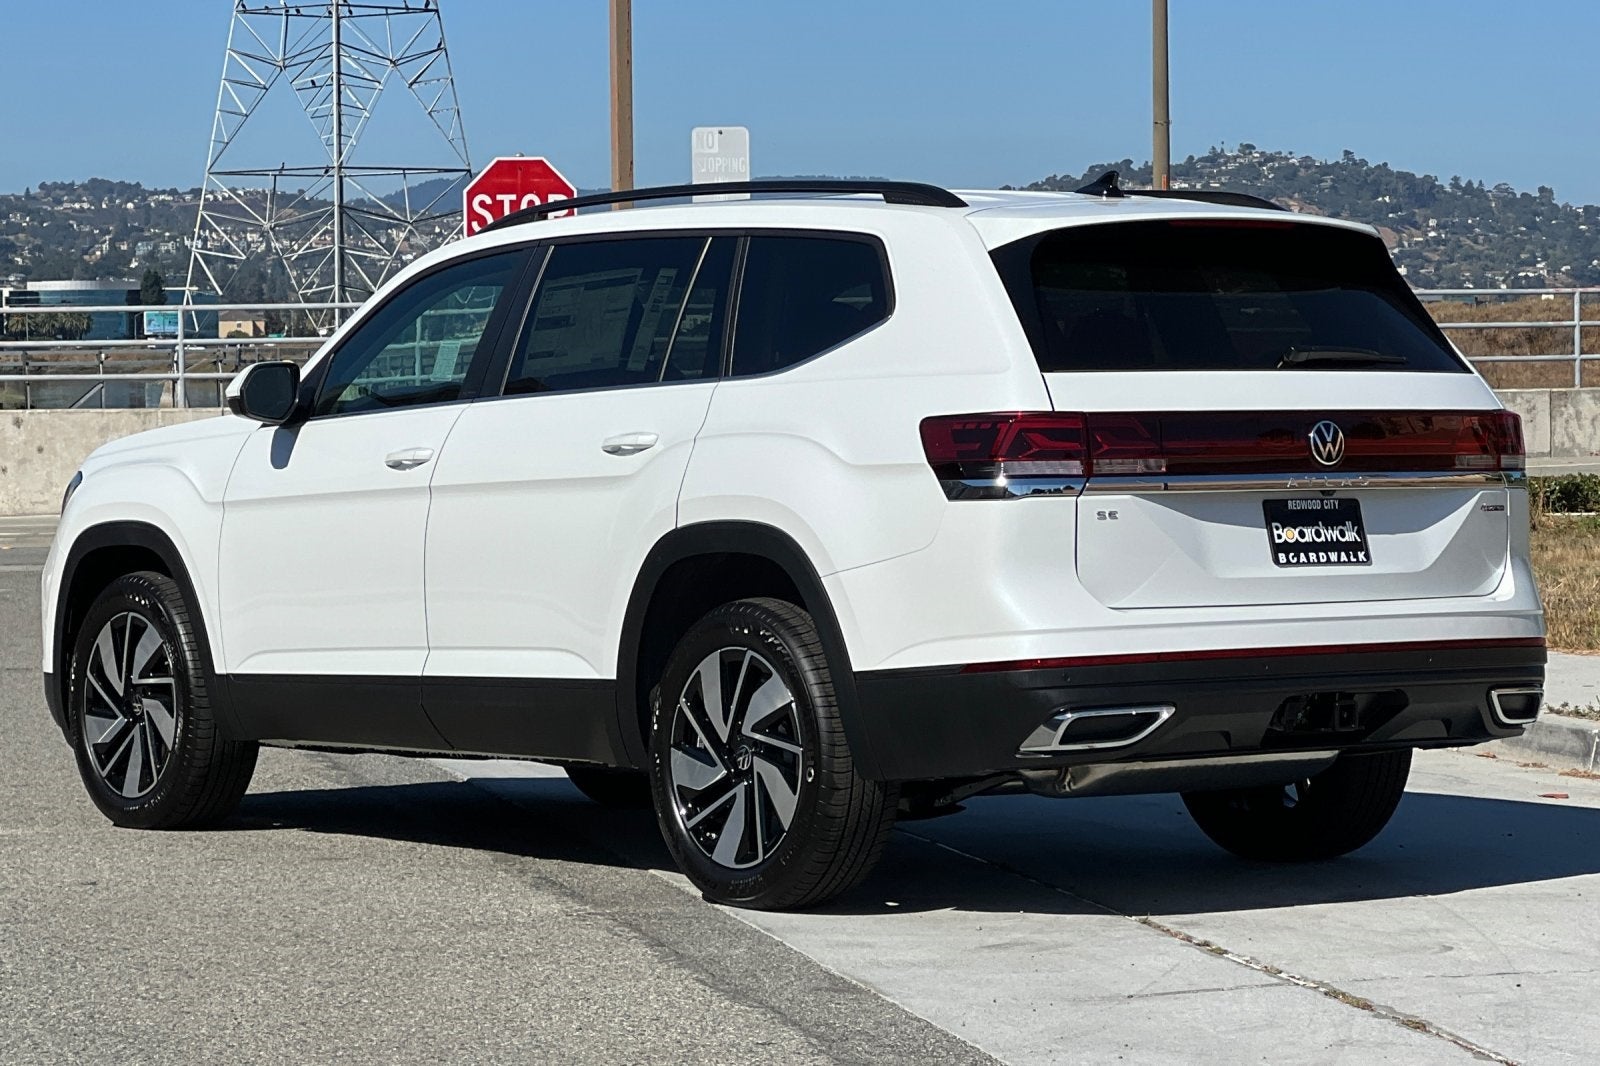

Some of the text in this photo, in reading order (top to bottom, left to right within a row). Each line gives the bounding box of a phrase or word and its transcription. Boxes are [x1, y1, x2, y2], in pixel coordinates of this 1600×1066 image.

[1287, 499, 1339, 510] REDWOOD CITY
[1096, 510, 1119, 521] SE
[1271, 520, 1362, 544] Boardwalk
